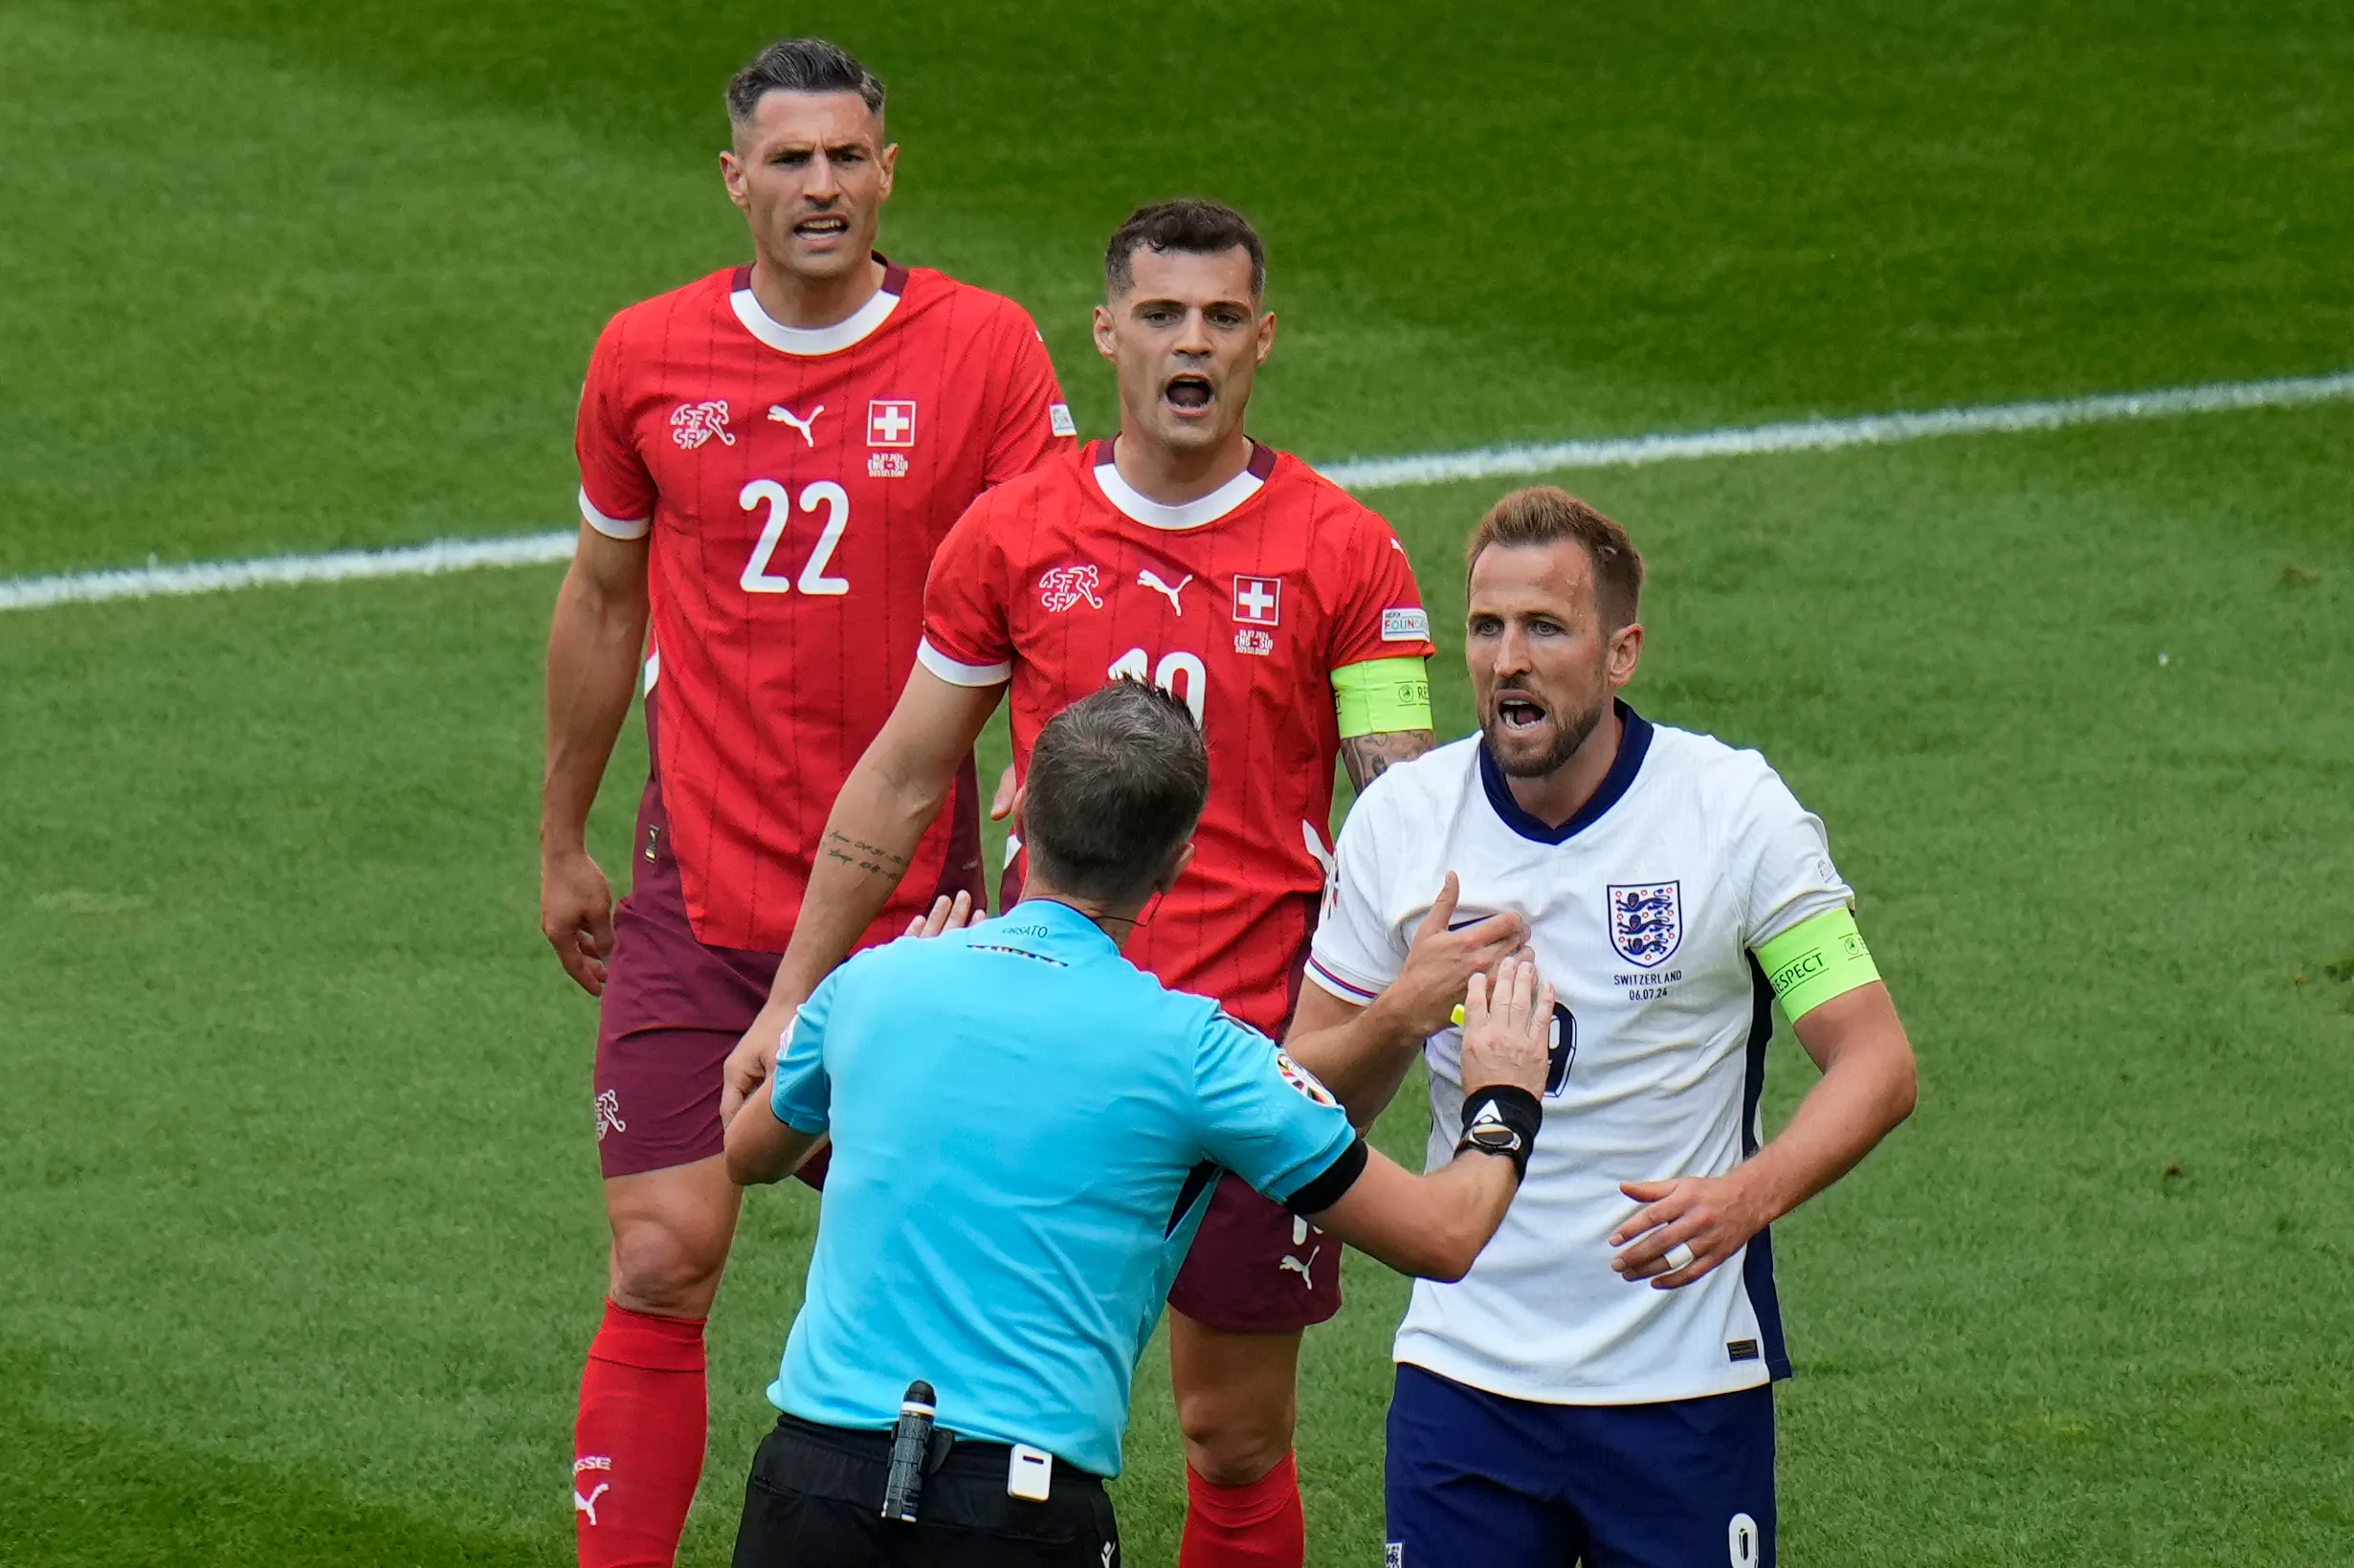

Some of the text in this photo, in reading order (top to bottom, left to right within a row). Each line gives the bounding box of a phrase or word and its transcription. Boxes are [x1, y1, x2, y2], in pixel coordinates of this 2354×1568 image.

[739, 478, 850, 595] 22
[1417, 686, 1430, 700] RE
[1613, 970, 1682, 985] SWITZERLAND
[1629, 987, 1668, 1002] 06.07.24
